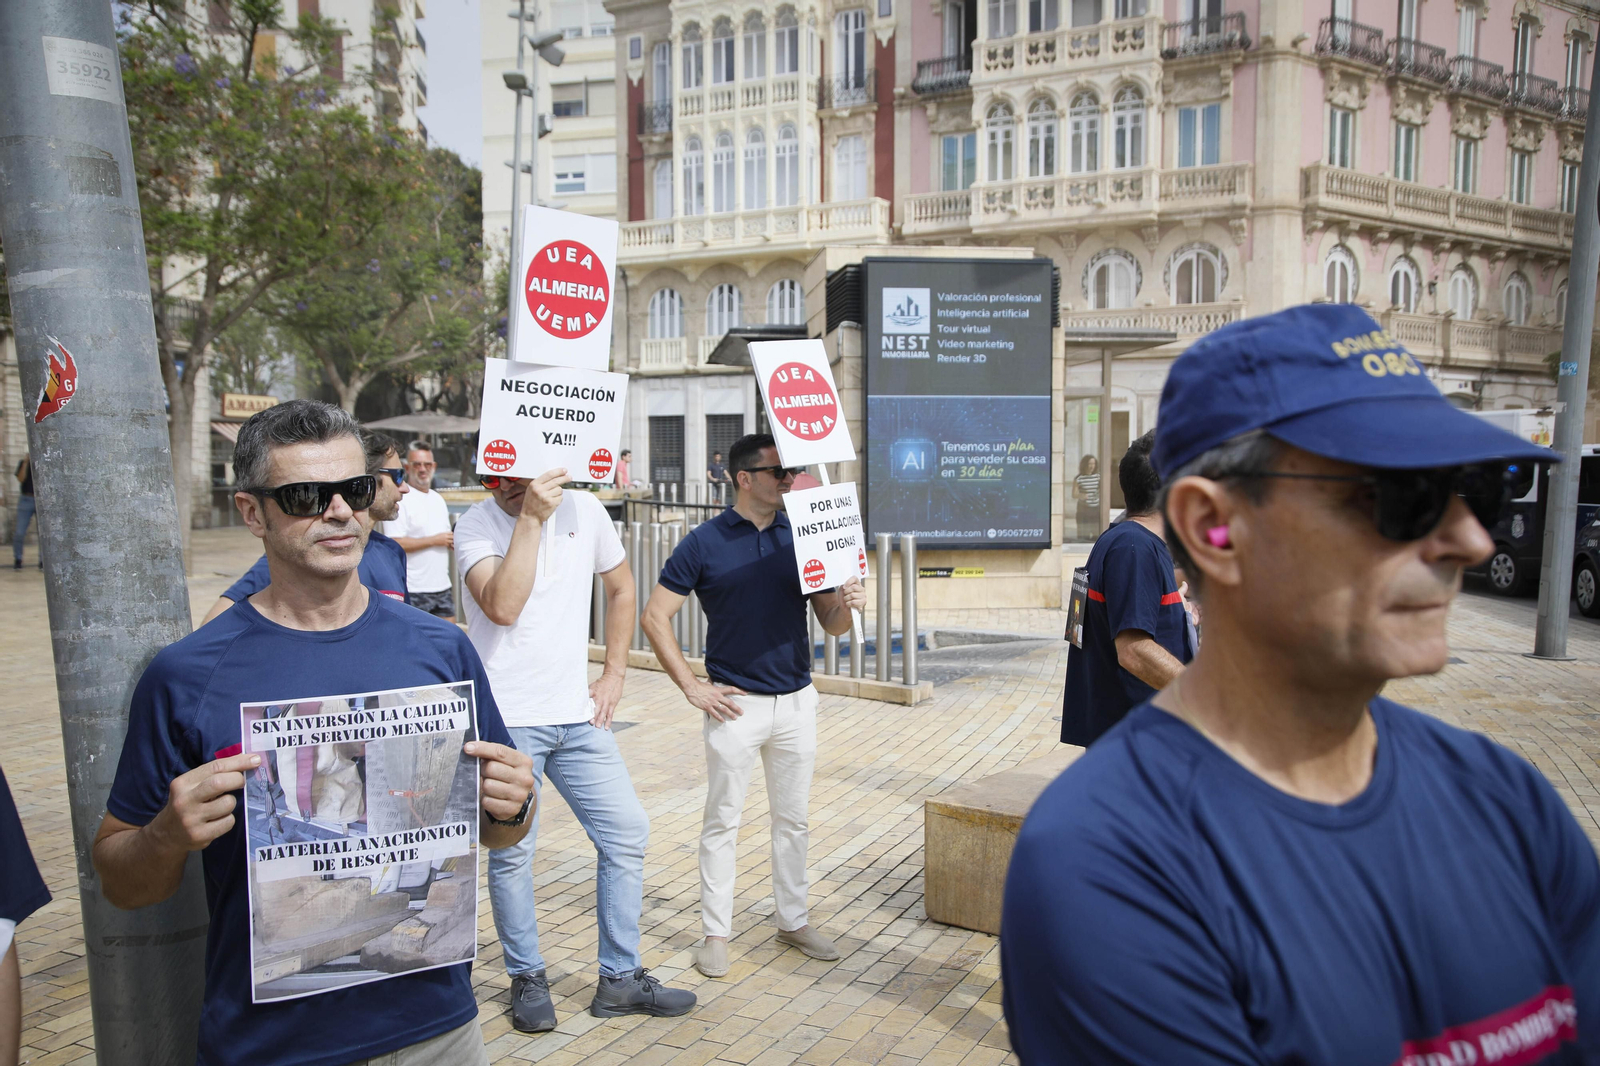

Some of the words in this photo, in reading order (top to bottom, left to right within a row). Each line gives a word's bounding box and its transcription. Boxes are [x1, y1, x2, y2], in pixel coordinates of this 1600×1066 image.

[56, 60, 112, 82] 35922
[546, 246, 593, 271] UEA
[528, 276, 606, 302] ALMERIA
[937, 292, 988, 302] Valoración
[990, 293, 1042, 303] profesional
[536, 303, 598, 332] UEMA
[937, 308, 990, 319] Inteligencia
[992, 309, 1030, 318] artificial
[937, 324, 959, 333] Tour
[961, 324, 991, 333] virtual
[881, 336, 931, 350] NEST
[937, 339, 965, 348] Video
[967, 339, 1015, 351] marketing
[881, 351, 931, 359] INMOBILIARIA
[936, 353, 971, 363] Render
[973, 353, 987, 363] 3D
[776, 367, 815, 384] UEA
[500, 378, 616, 403] NEGOCIACIÓN
[773, 393, 835, 409] ALMERIA
[515, 404, 596, 423] ACUERDO
[786, 415, 835, 435] UEMA
[491, 441, 510, 450] UEA
[542, 431, 577, 447] YA!!!
[941, 441, 990, 451] Tenemos
[993, 443, 1007, 451] un
[1007, 438, 1035, 455] plan
[484, 451, 516, 460] ALMERIA
[902, 451, 925, 470] AI
[941, 455, 965, 466] para
[967, 453, 1004, 464] vender
[1006, 456, 1019, 464] su
[1021, 456, 1046, 464] casa
[487, 460, 512, 470] UEMA
[941, 469, 955, 477] en
[960, 466, 976, 477] 30
[810, 499, 833, 514] POR
[834, 496, 852, 509] UNAS
[797, 514, 861, 537] INSTALACIONES
[997, 529, 1044, 538] 950672787
[826, 535, 856, 552] DIGNAS
[252, 719, 281, 735] SIN
[286, 710, 375, 732] INVERSIÓN
[380, 709, 399, 722] LA
[403, 700, 467, 719] CALIDAD
[276, 734, 307, 748] DEL
[311, 726, 387, 745] SERVICIO
[391, 718, 455, 736] MENGUA
[258, 840, 352, 863] MATERIAL
[356, 823, 467, 849] ANACRÓNICO
[312, 858, 336, 872] DE
[341, 848, 419, 869] RESCATE
